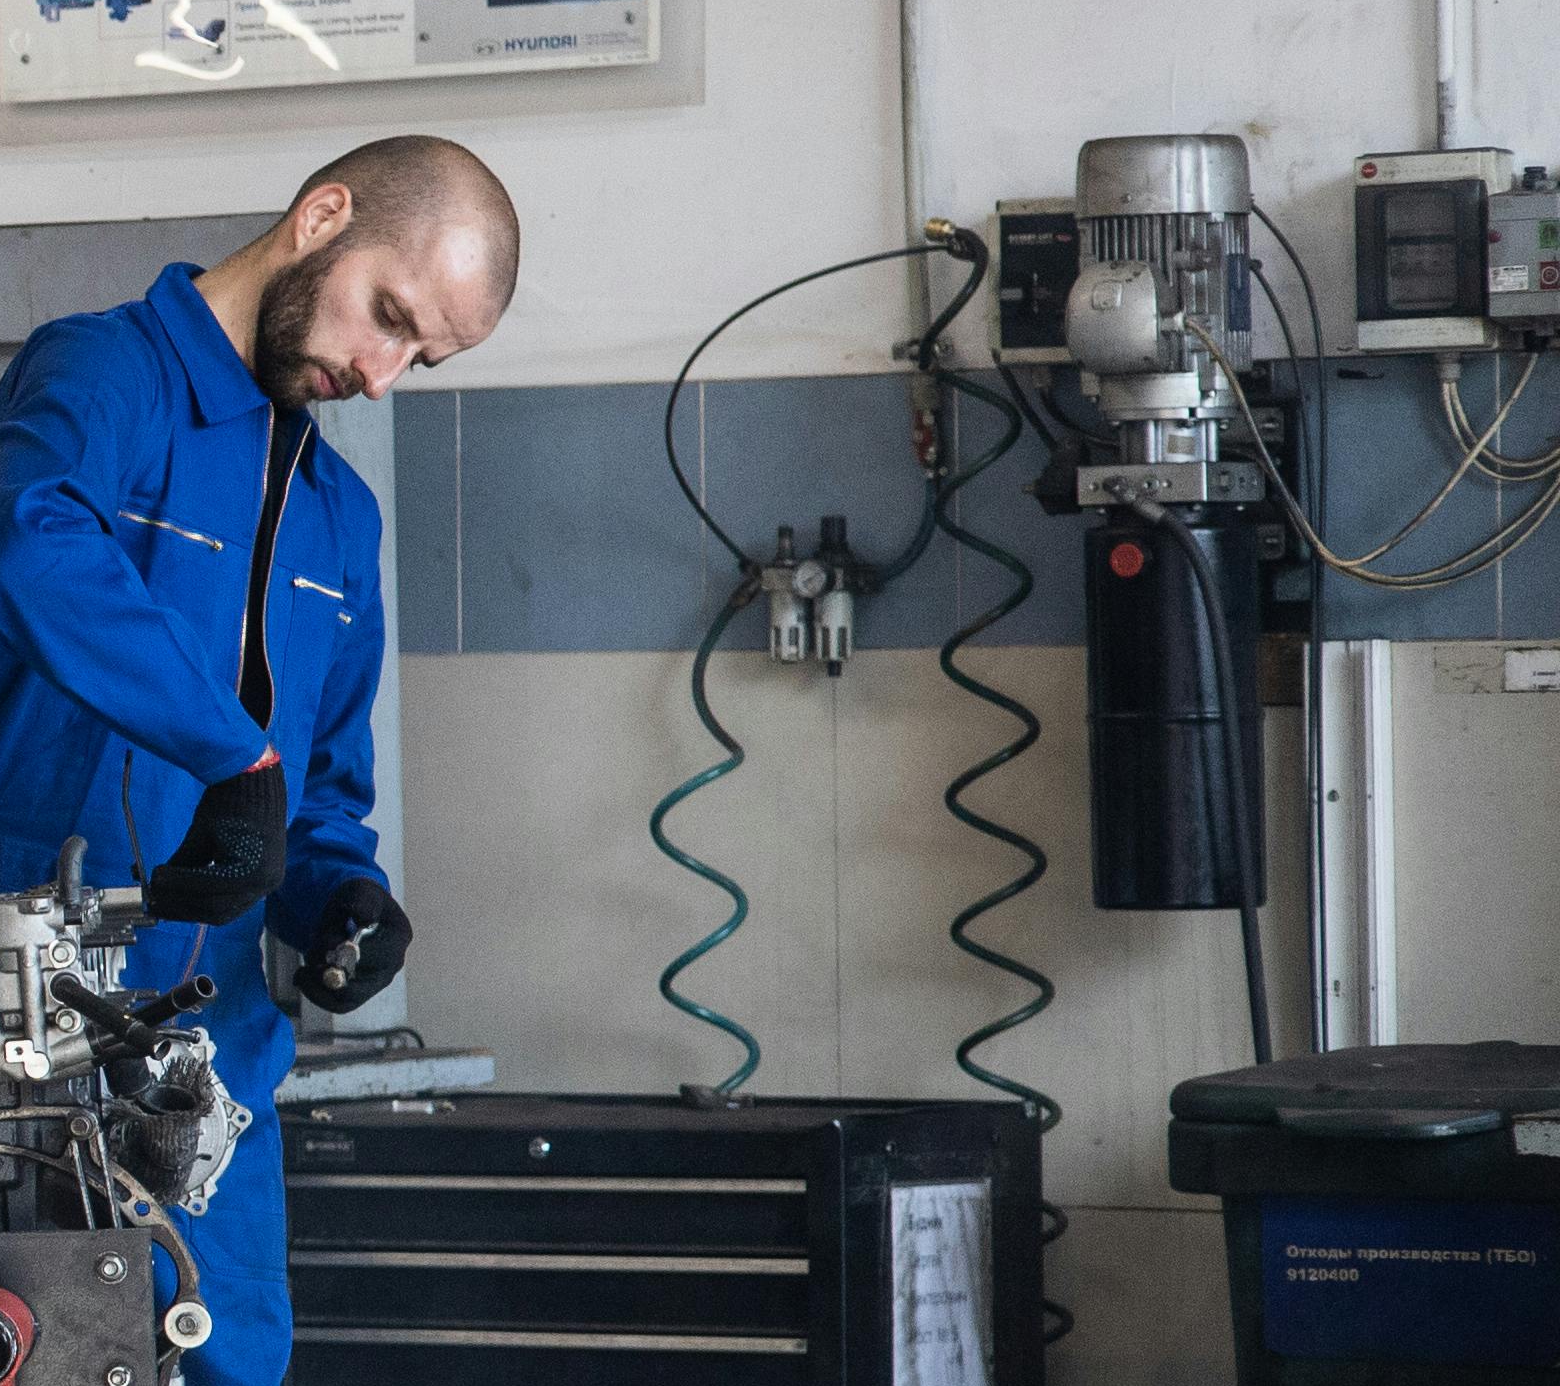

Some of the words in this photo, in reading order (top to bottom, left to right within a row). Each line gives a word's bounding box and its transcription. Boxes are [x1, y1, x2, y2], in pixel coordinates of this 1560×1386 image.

[504, 34, 578, 52] HYUNDAI
[1286, 1244, 1352, 1260] Отходы
[1357, 1247, 1481, 1262] производства
[1487, 1248, 1537, 1265] (ТБО)
[1286, 1268, 1360, 1282] 9120400
